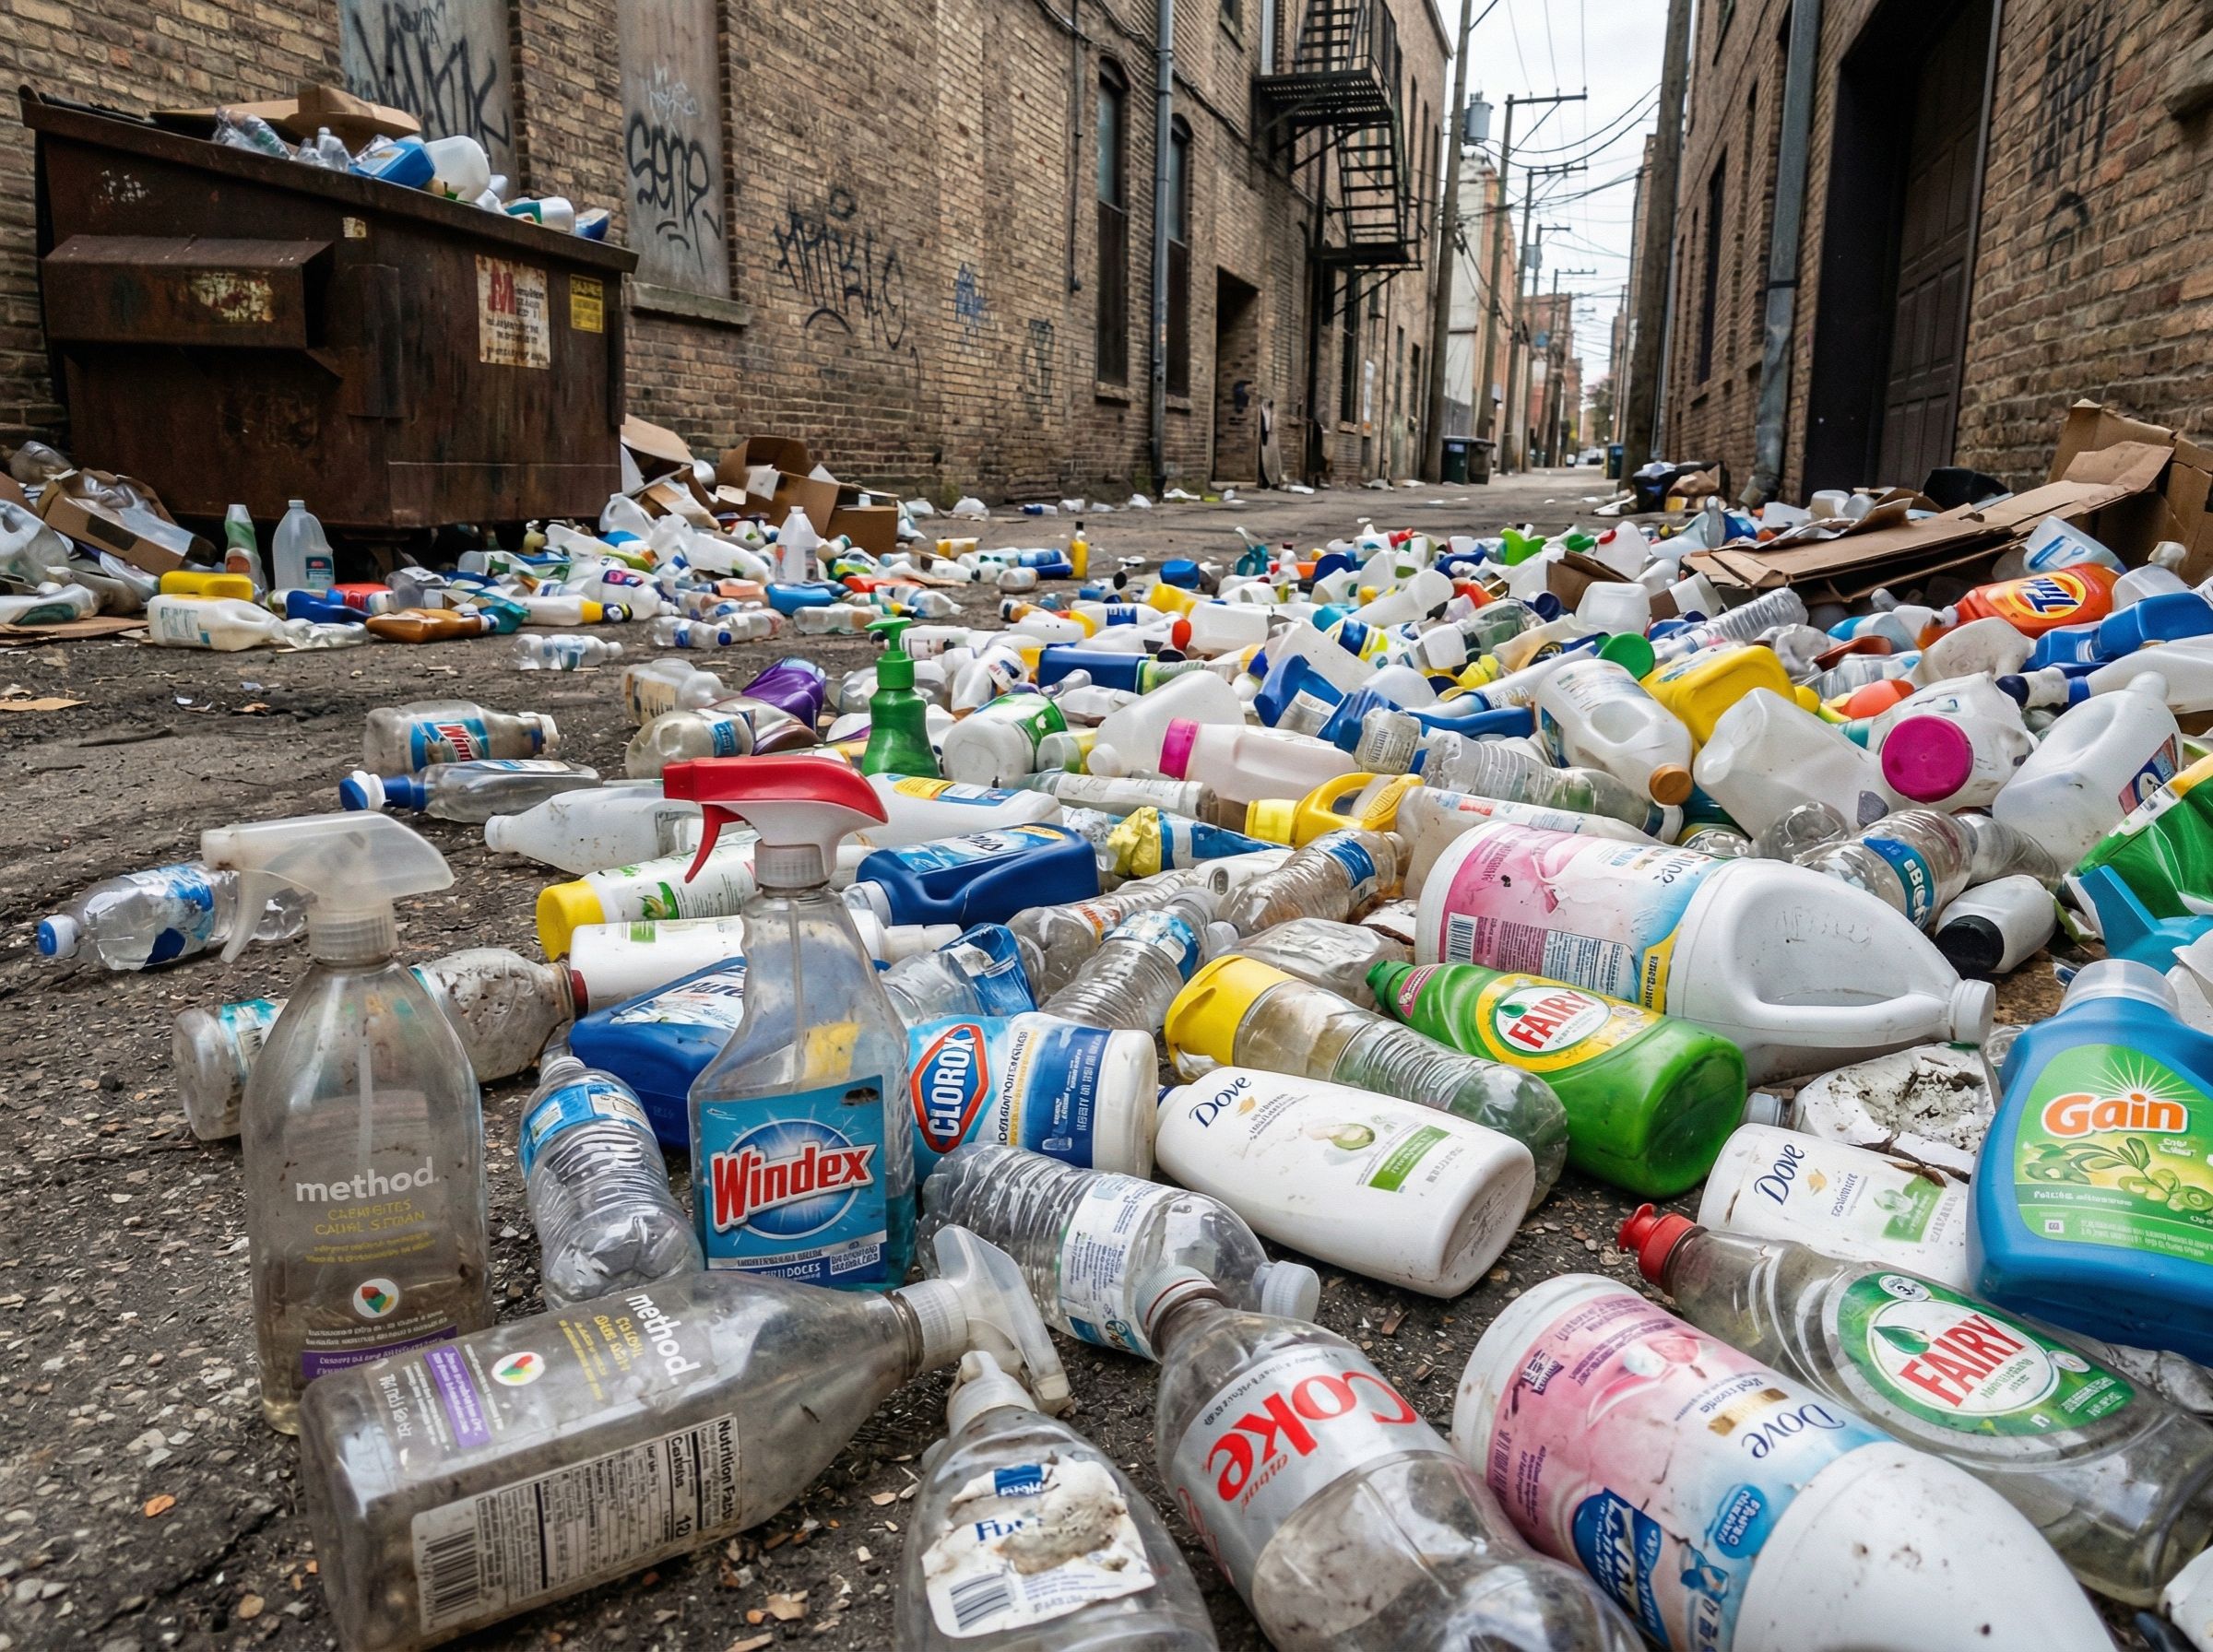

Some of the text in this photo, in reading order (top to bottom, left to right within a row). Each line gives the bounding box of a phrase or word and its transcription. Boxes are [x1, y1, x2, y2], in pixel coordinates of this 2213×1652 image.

[1507, 990, 1597, 1050] FAIRY
[928, 1036, 976, 1138] CLOROX
[1189, 1077, 1252, 1128] Dove
[2043, 1092, 2185, 1137] Gain
[713, 1145, 872, 1227] Windex
[1754, 1143, 1806, 1206] Dove
[1899, 1314, 2026, 1407] FAIRY
[1207, 1371, 1418, 1502] Coke
[1741, 1403, 1846, 1459] Dove
